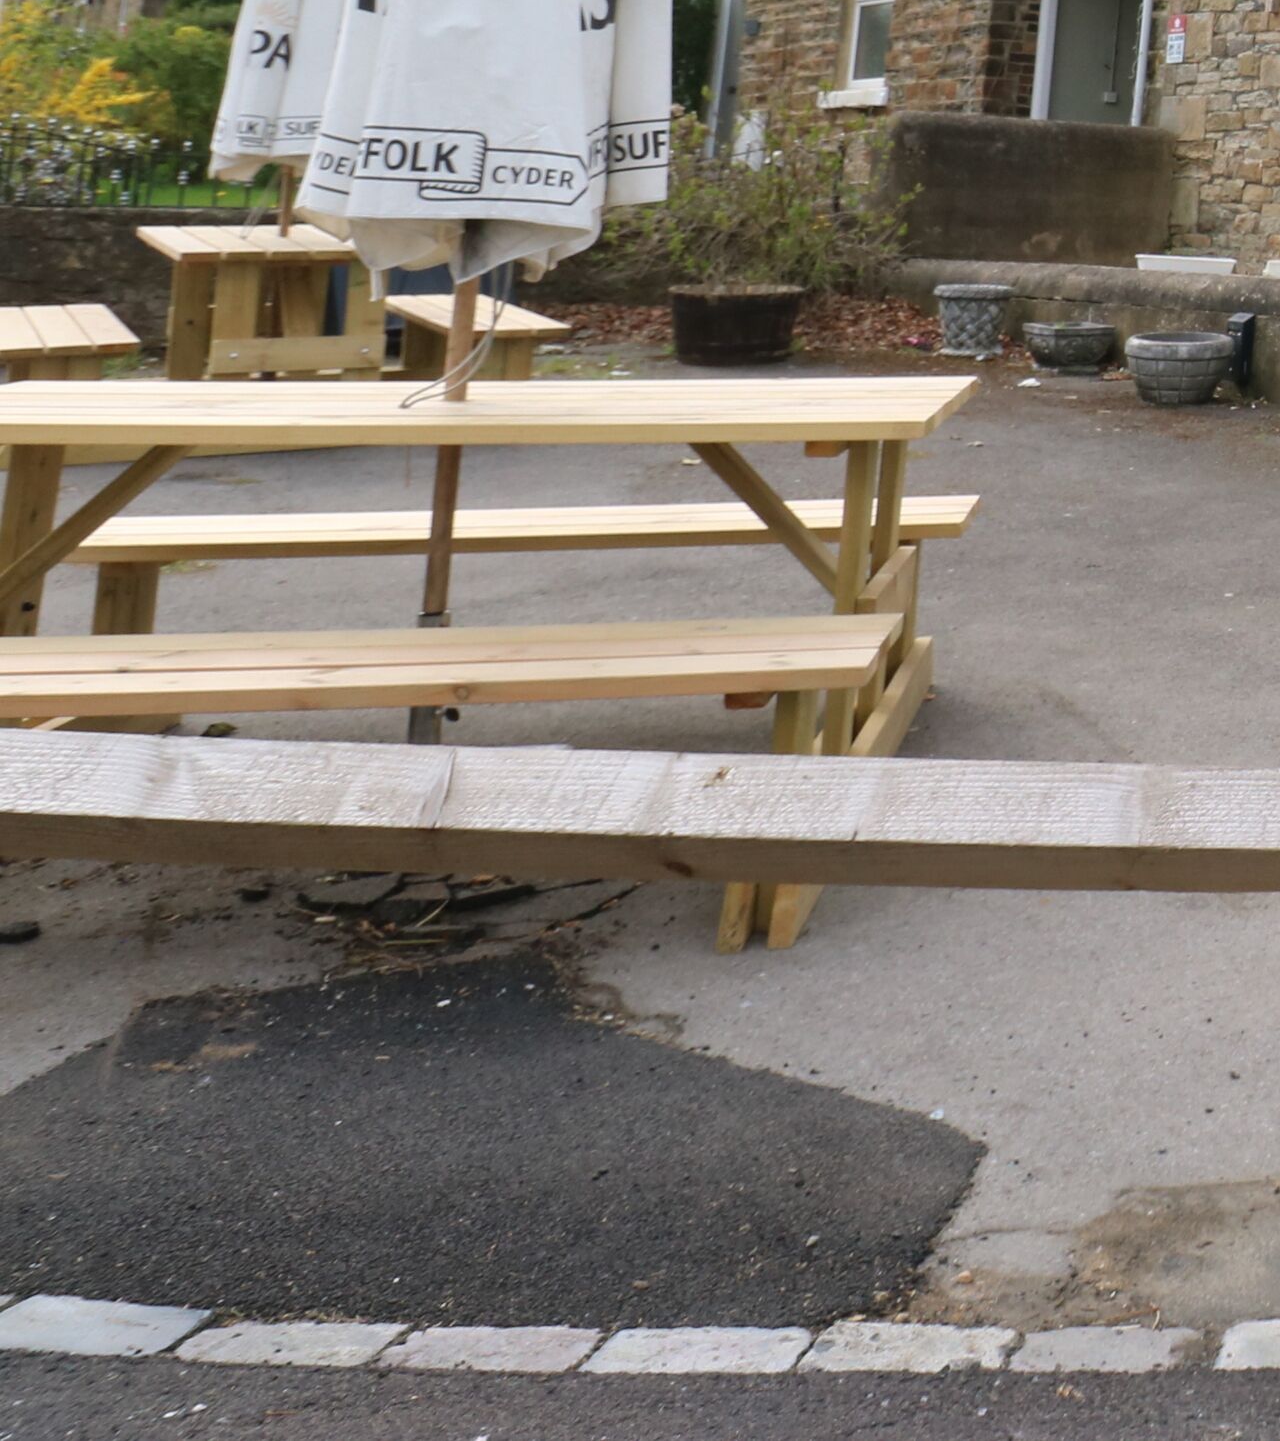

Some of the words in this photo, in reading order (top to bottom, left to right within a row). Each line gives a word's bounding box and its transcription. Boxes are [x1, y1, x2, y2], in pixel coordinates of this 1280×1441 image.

[360, 137, 460, 174] FOLK
[492, 165, 575, 190] CYDER
[613, 130, 667, 163] SUF
